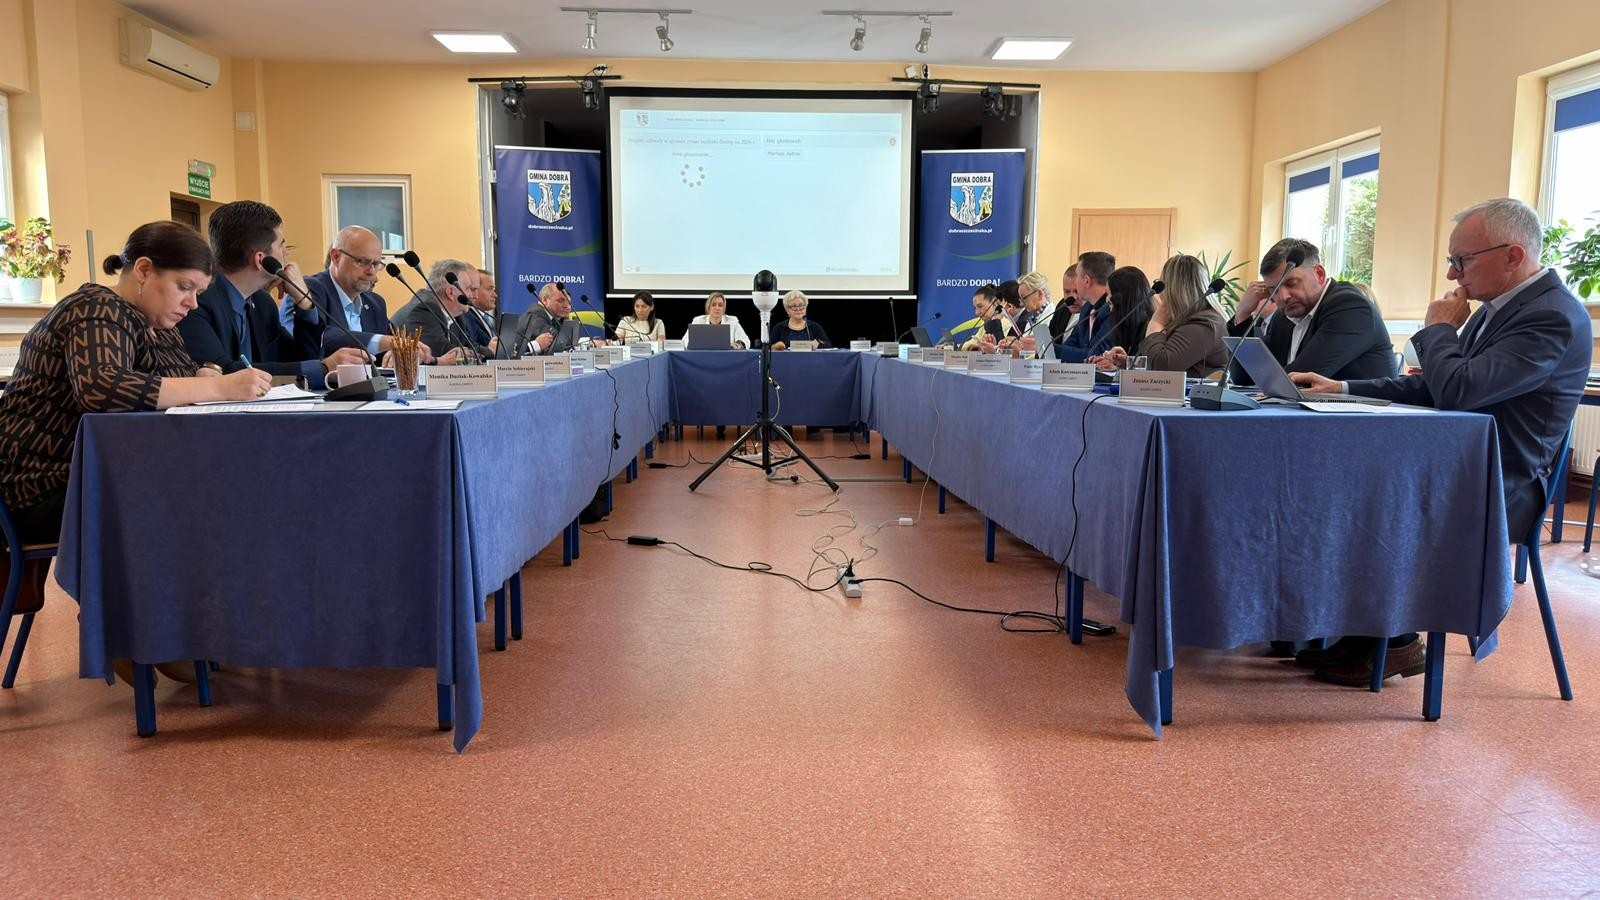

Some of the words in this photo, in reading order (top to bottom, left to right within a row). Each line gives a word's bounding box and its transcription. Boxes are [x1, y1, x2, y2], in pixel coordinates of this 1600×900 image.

[529, 172, 548, 180] GMINA
[549, 173, 569, 181] DOBRA
[972, 176, 992, 184] DOBRA
[518, 274, 552, 283] BARDZO
[553, 275, 585, 284] DOBRA!
[936, 278, 968, 287] BARDZO
